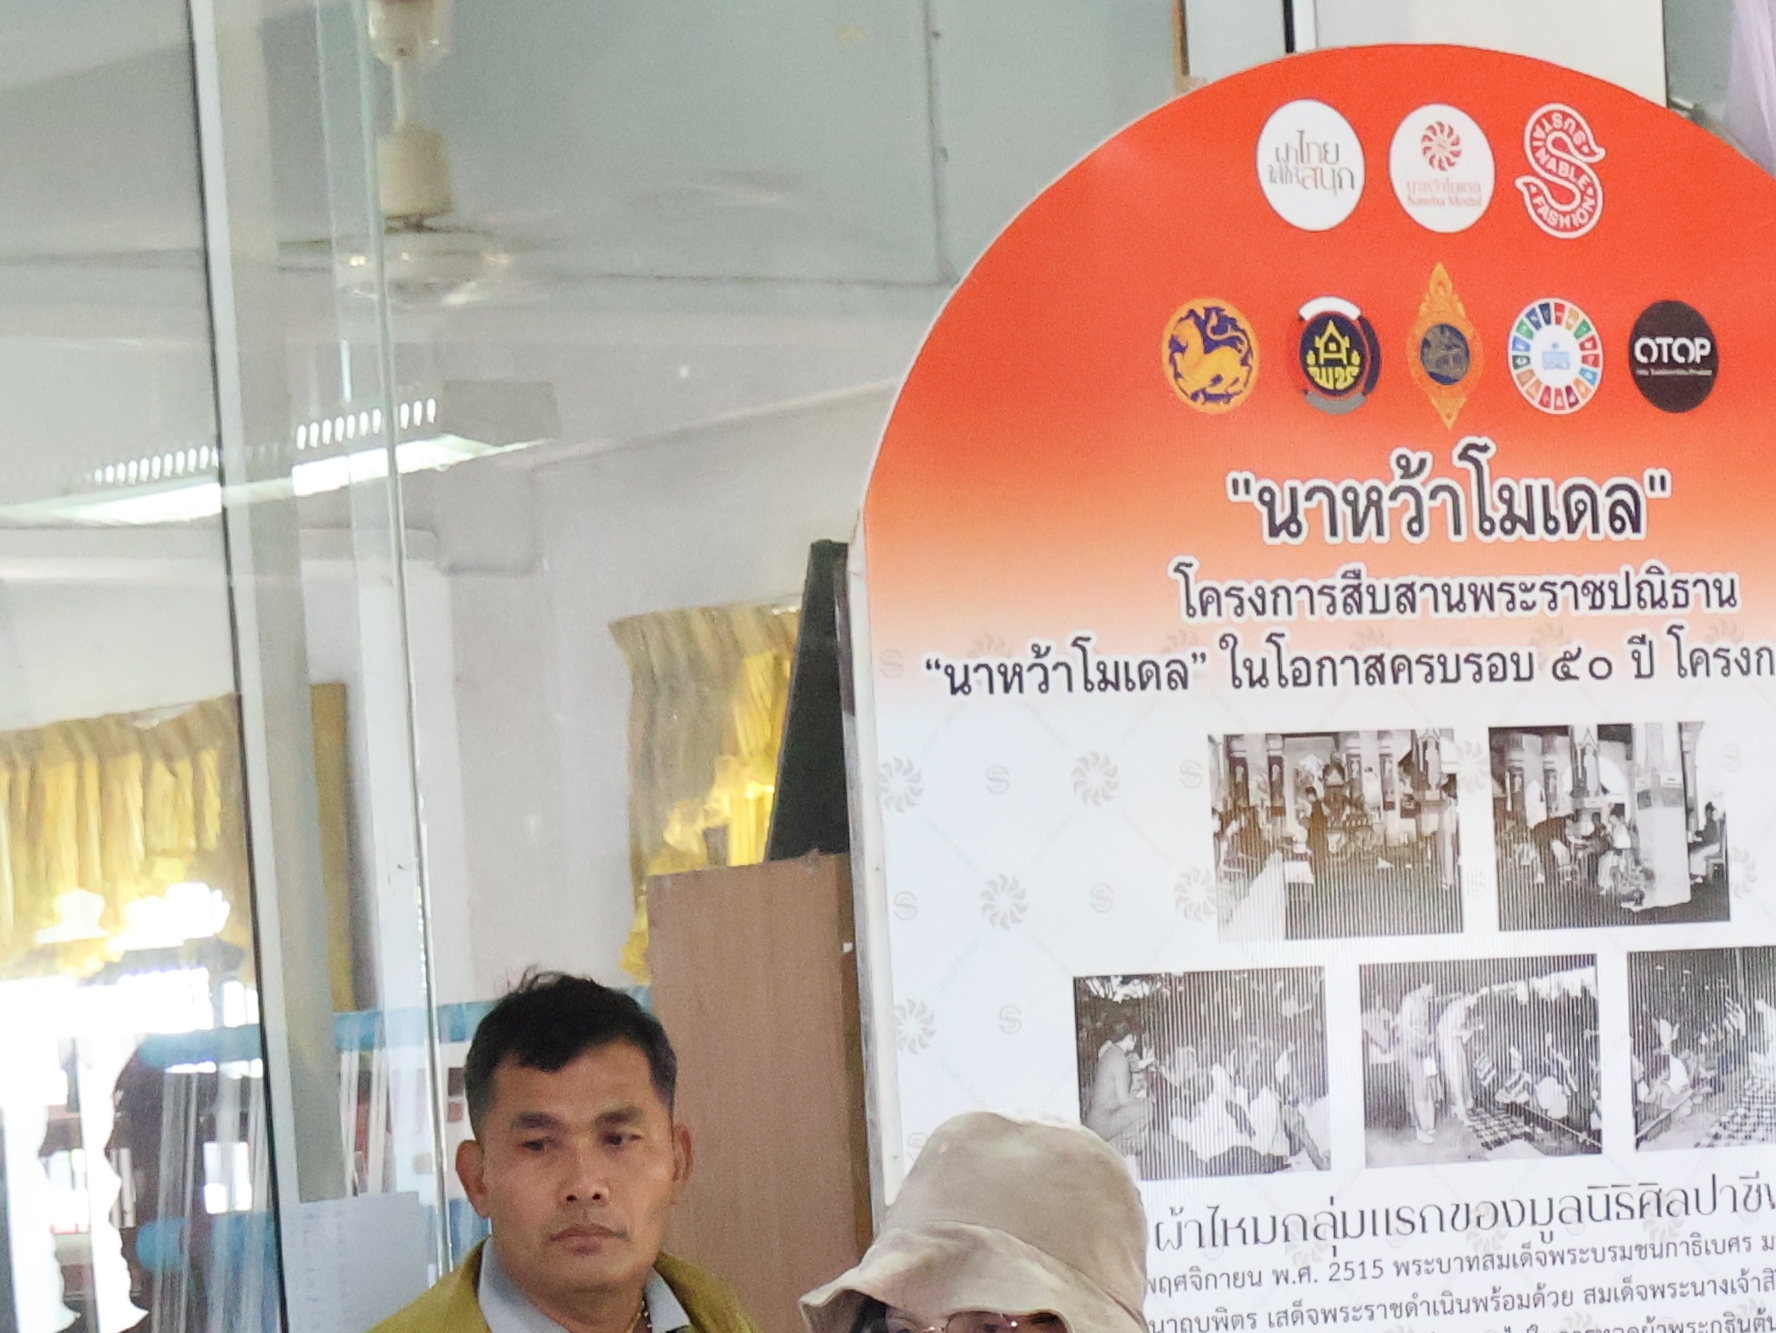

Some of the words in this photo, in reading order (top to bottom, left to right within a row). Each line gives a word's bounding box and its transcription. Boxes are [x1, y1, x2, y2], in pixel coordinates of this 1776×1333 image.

[1531, 194, 1597, 229] FASHION
[1634, 336, 1712, 364] OTOP
[1229, 442, 1671, 546] "นาหว้าโมเดล"
[1172, 560, 1741, 622] โครงการสืบสานพระราชปณิธาน
[924, 646, 1208, 700] “นาหว้าโมเดล”
[1217, 636, 1536, 692] ในโอกาสครบรอบ
[1550, 652, 1614, 684] ๕๐
[1630, 634, 1656, 682] ปี
[1271, 1264, 1318, 1286] พ.ศ.
[1327, 1257, 1384, 1282] 2515
[1267, 1281, 1574, 1328] เสด็จพระราชดำเนินพร้อมด้วย
